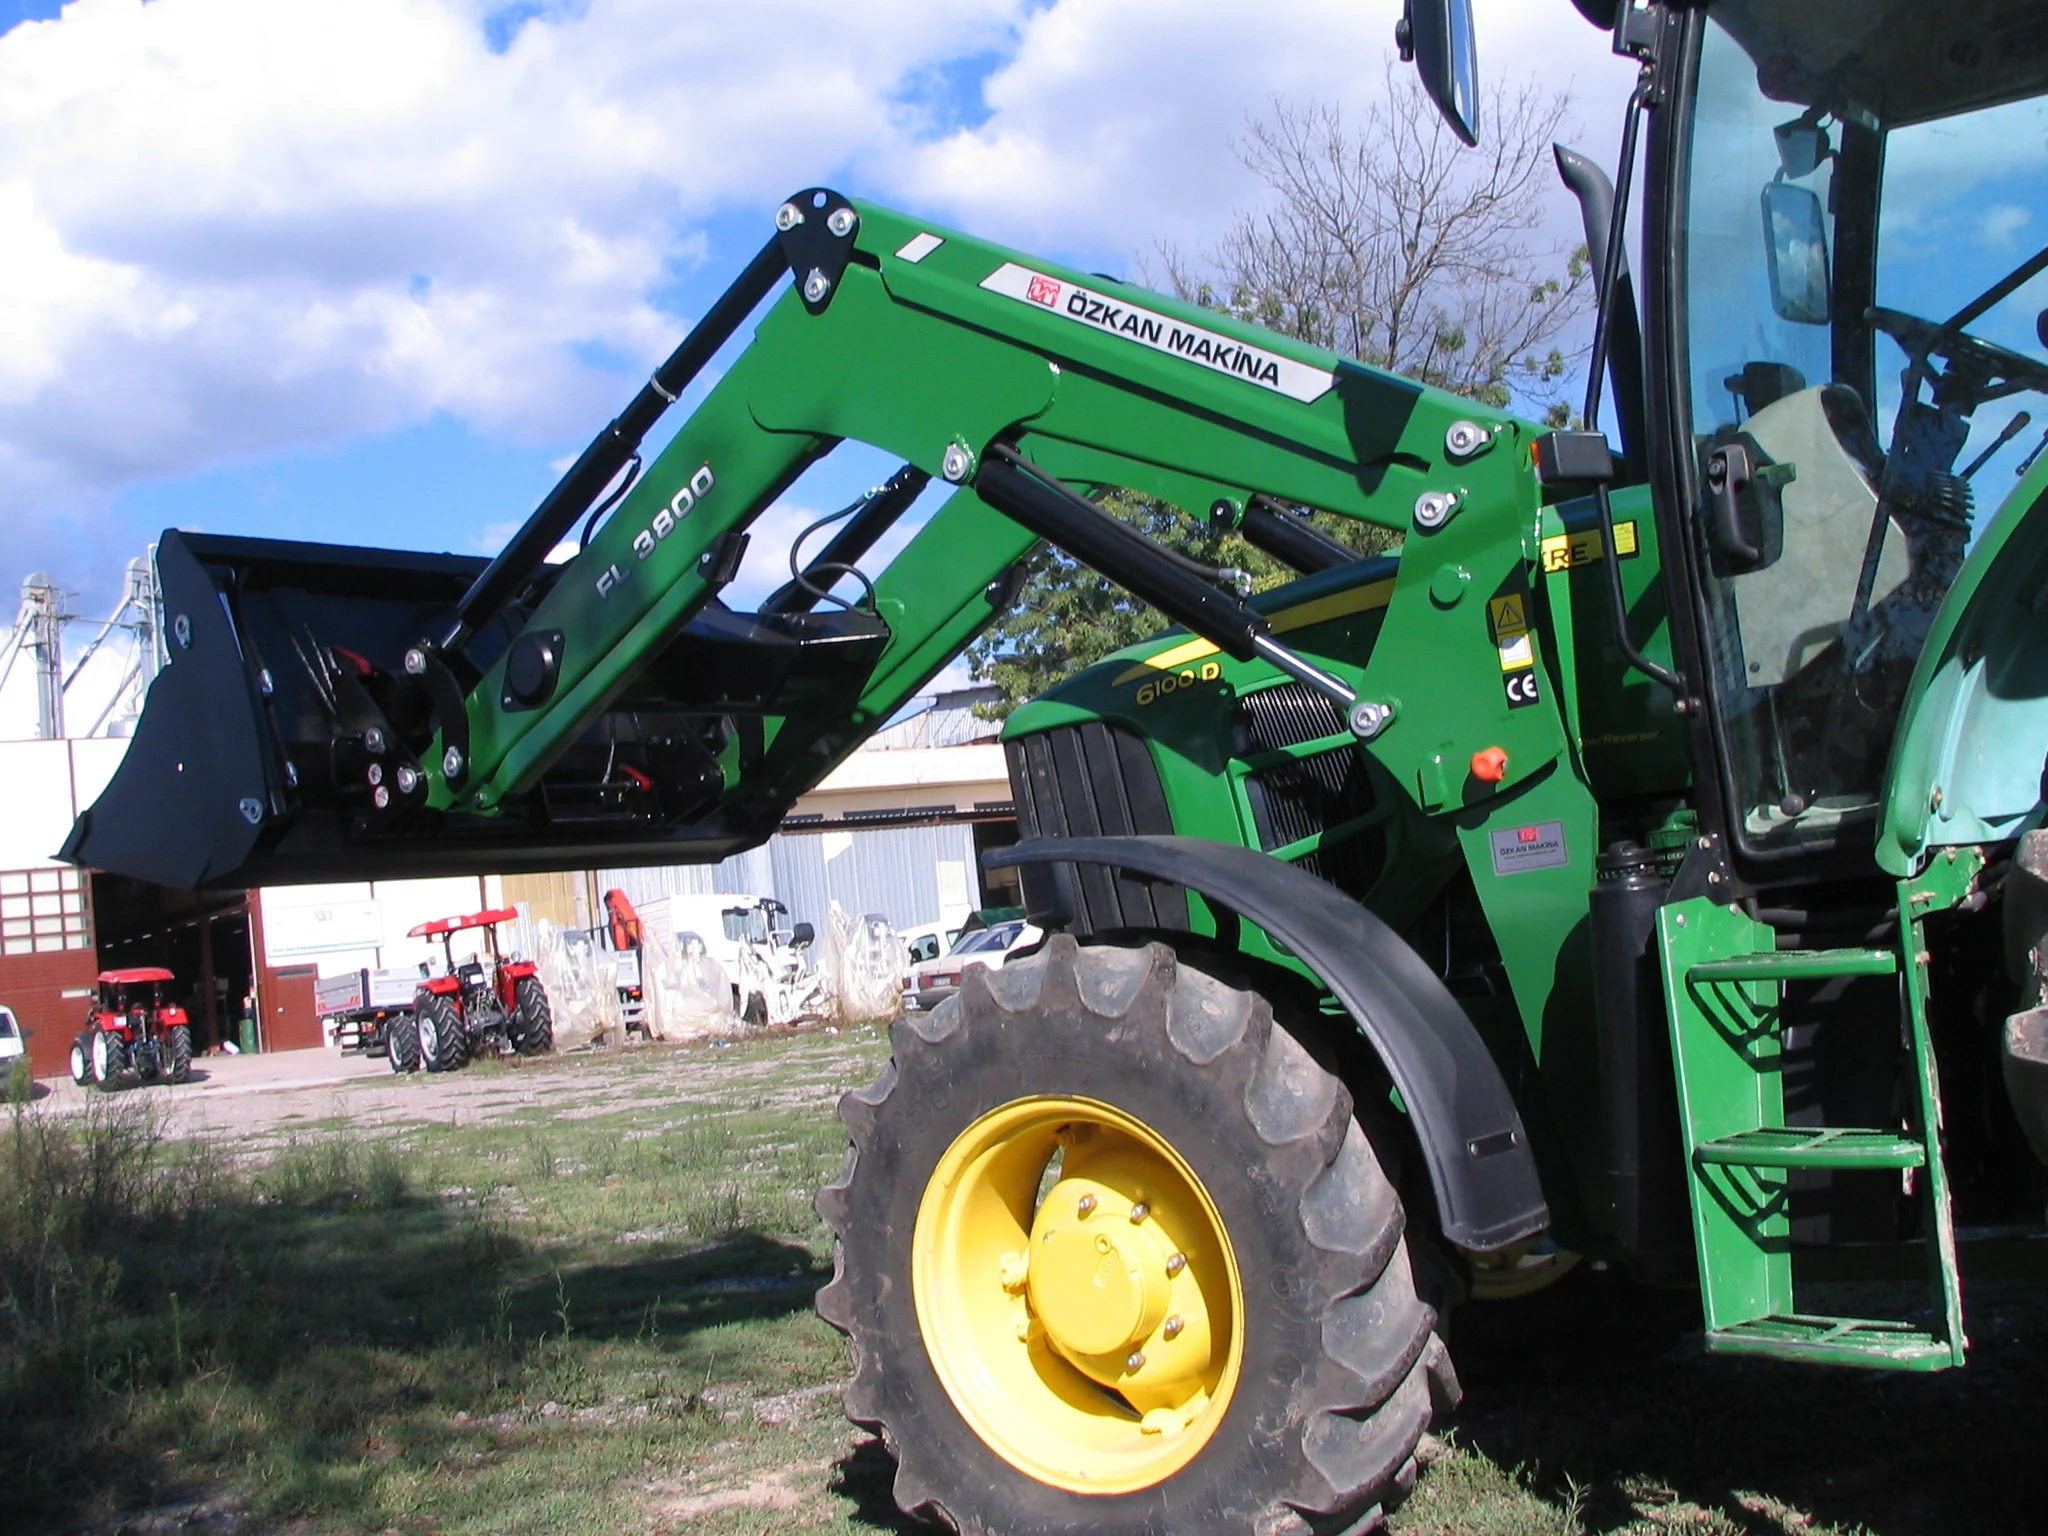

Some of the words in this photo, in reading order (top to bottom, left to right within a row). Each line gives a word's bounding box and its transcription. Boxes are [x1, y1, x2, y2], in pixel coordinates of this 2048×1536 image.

[1066, 289, 1163, 343] ÖZKAN
[1167, 328, 1279, 387] MAKİNA
[595, 564, 631, 600] FL
[632, 465, 715, 560] 3800
[1542, 542, 1589, 568] RE
[1135, 668, 1197, 706] 6100
[1201, 661, 1221, 681] D
[1506, 673, 1538, 702] CE
